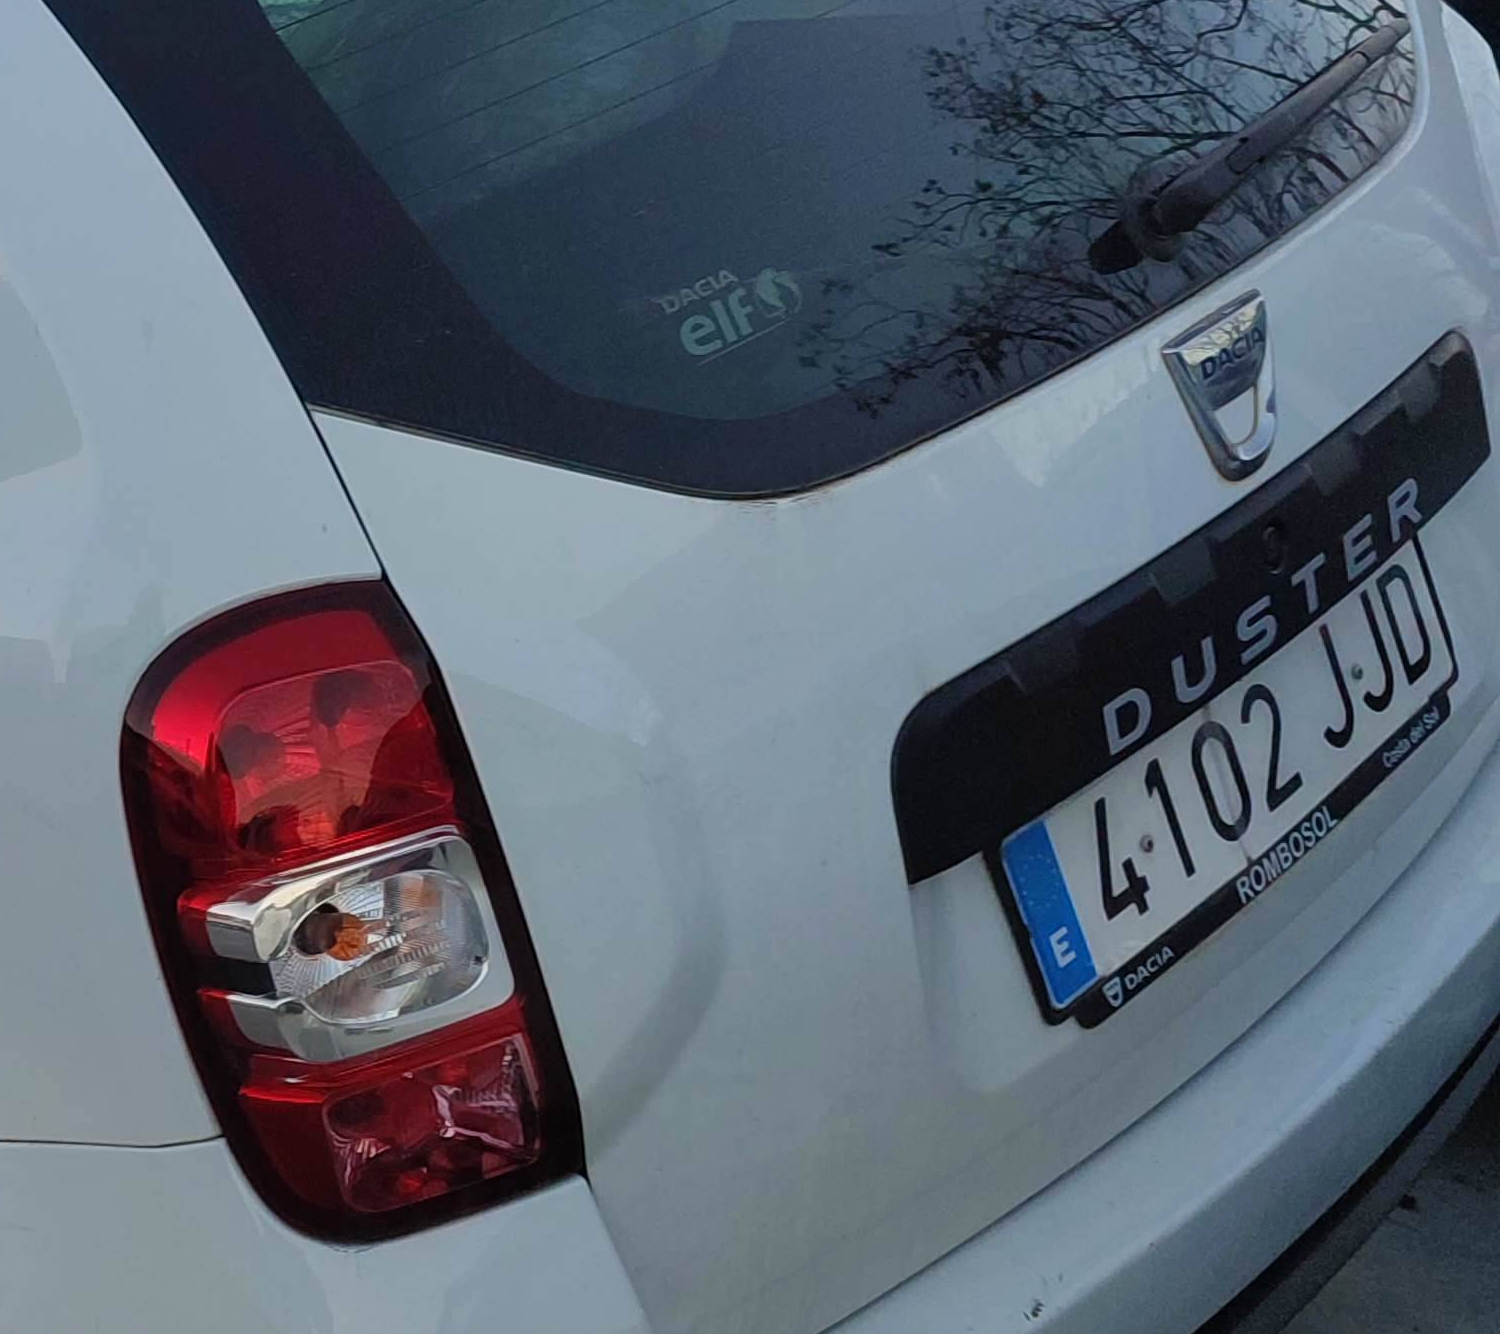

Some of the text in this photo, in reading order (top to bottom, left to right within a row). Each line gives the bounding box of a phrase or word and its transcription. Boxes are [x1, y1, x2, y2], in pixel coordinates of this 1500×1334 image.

[658, 269, 739, 315] DACIA
[680, 287, 754, 356] elf
[1201, 326, 1265, 380] DACIA
[1102, 477, 1423, 757] DUSTER
[1050, 563, 1433, 968] E 4102 JJD
[1124, 946, 1175, 990] DACIA
[1236, 804, 1339, 905] ROMBOSOL
